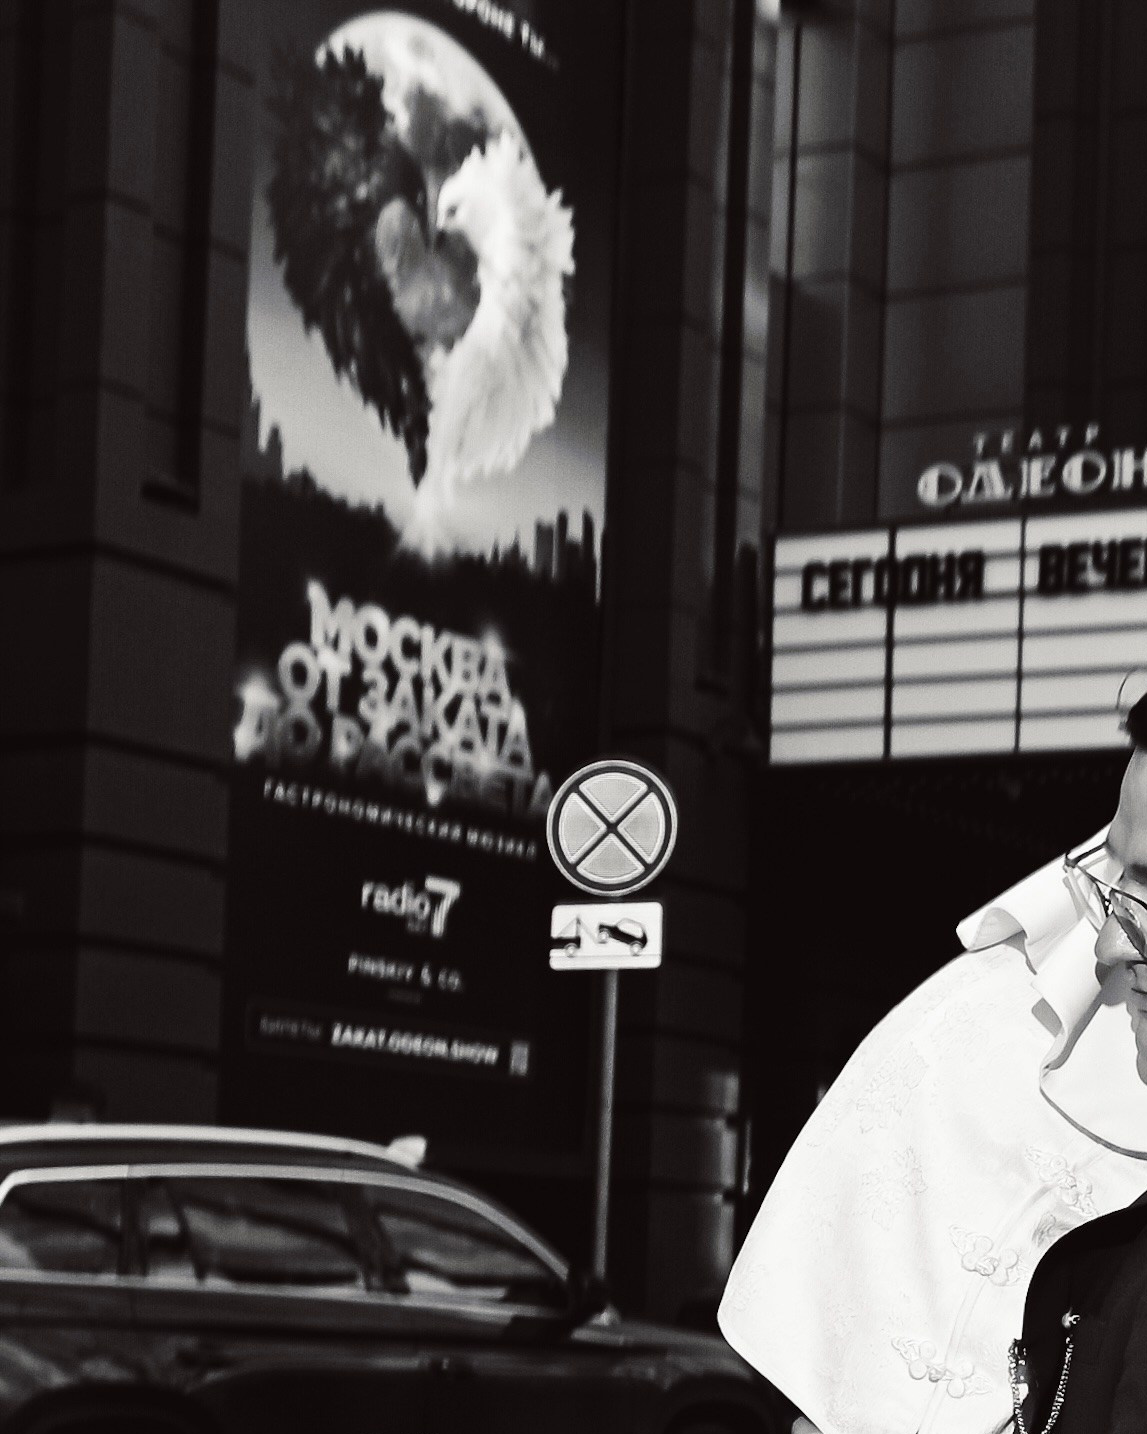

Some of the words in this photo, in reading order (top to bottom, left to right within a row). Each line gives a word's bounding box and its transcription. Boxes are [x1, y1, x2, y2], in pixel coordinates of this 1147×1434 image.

[307, 580, 512, 706] МОСКВА
[801, 549, 985, 612] СЕГОДНЯ
[277, 641, 351, 712] ОТ
[358, 667, 534, 778] ЗАКАТА
